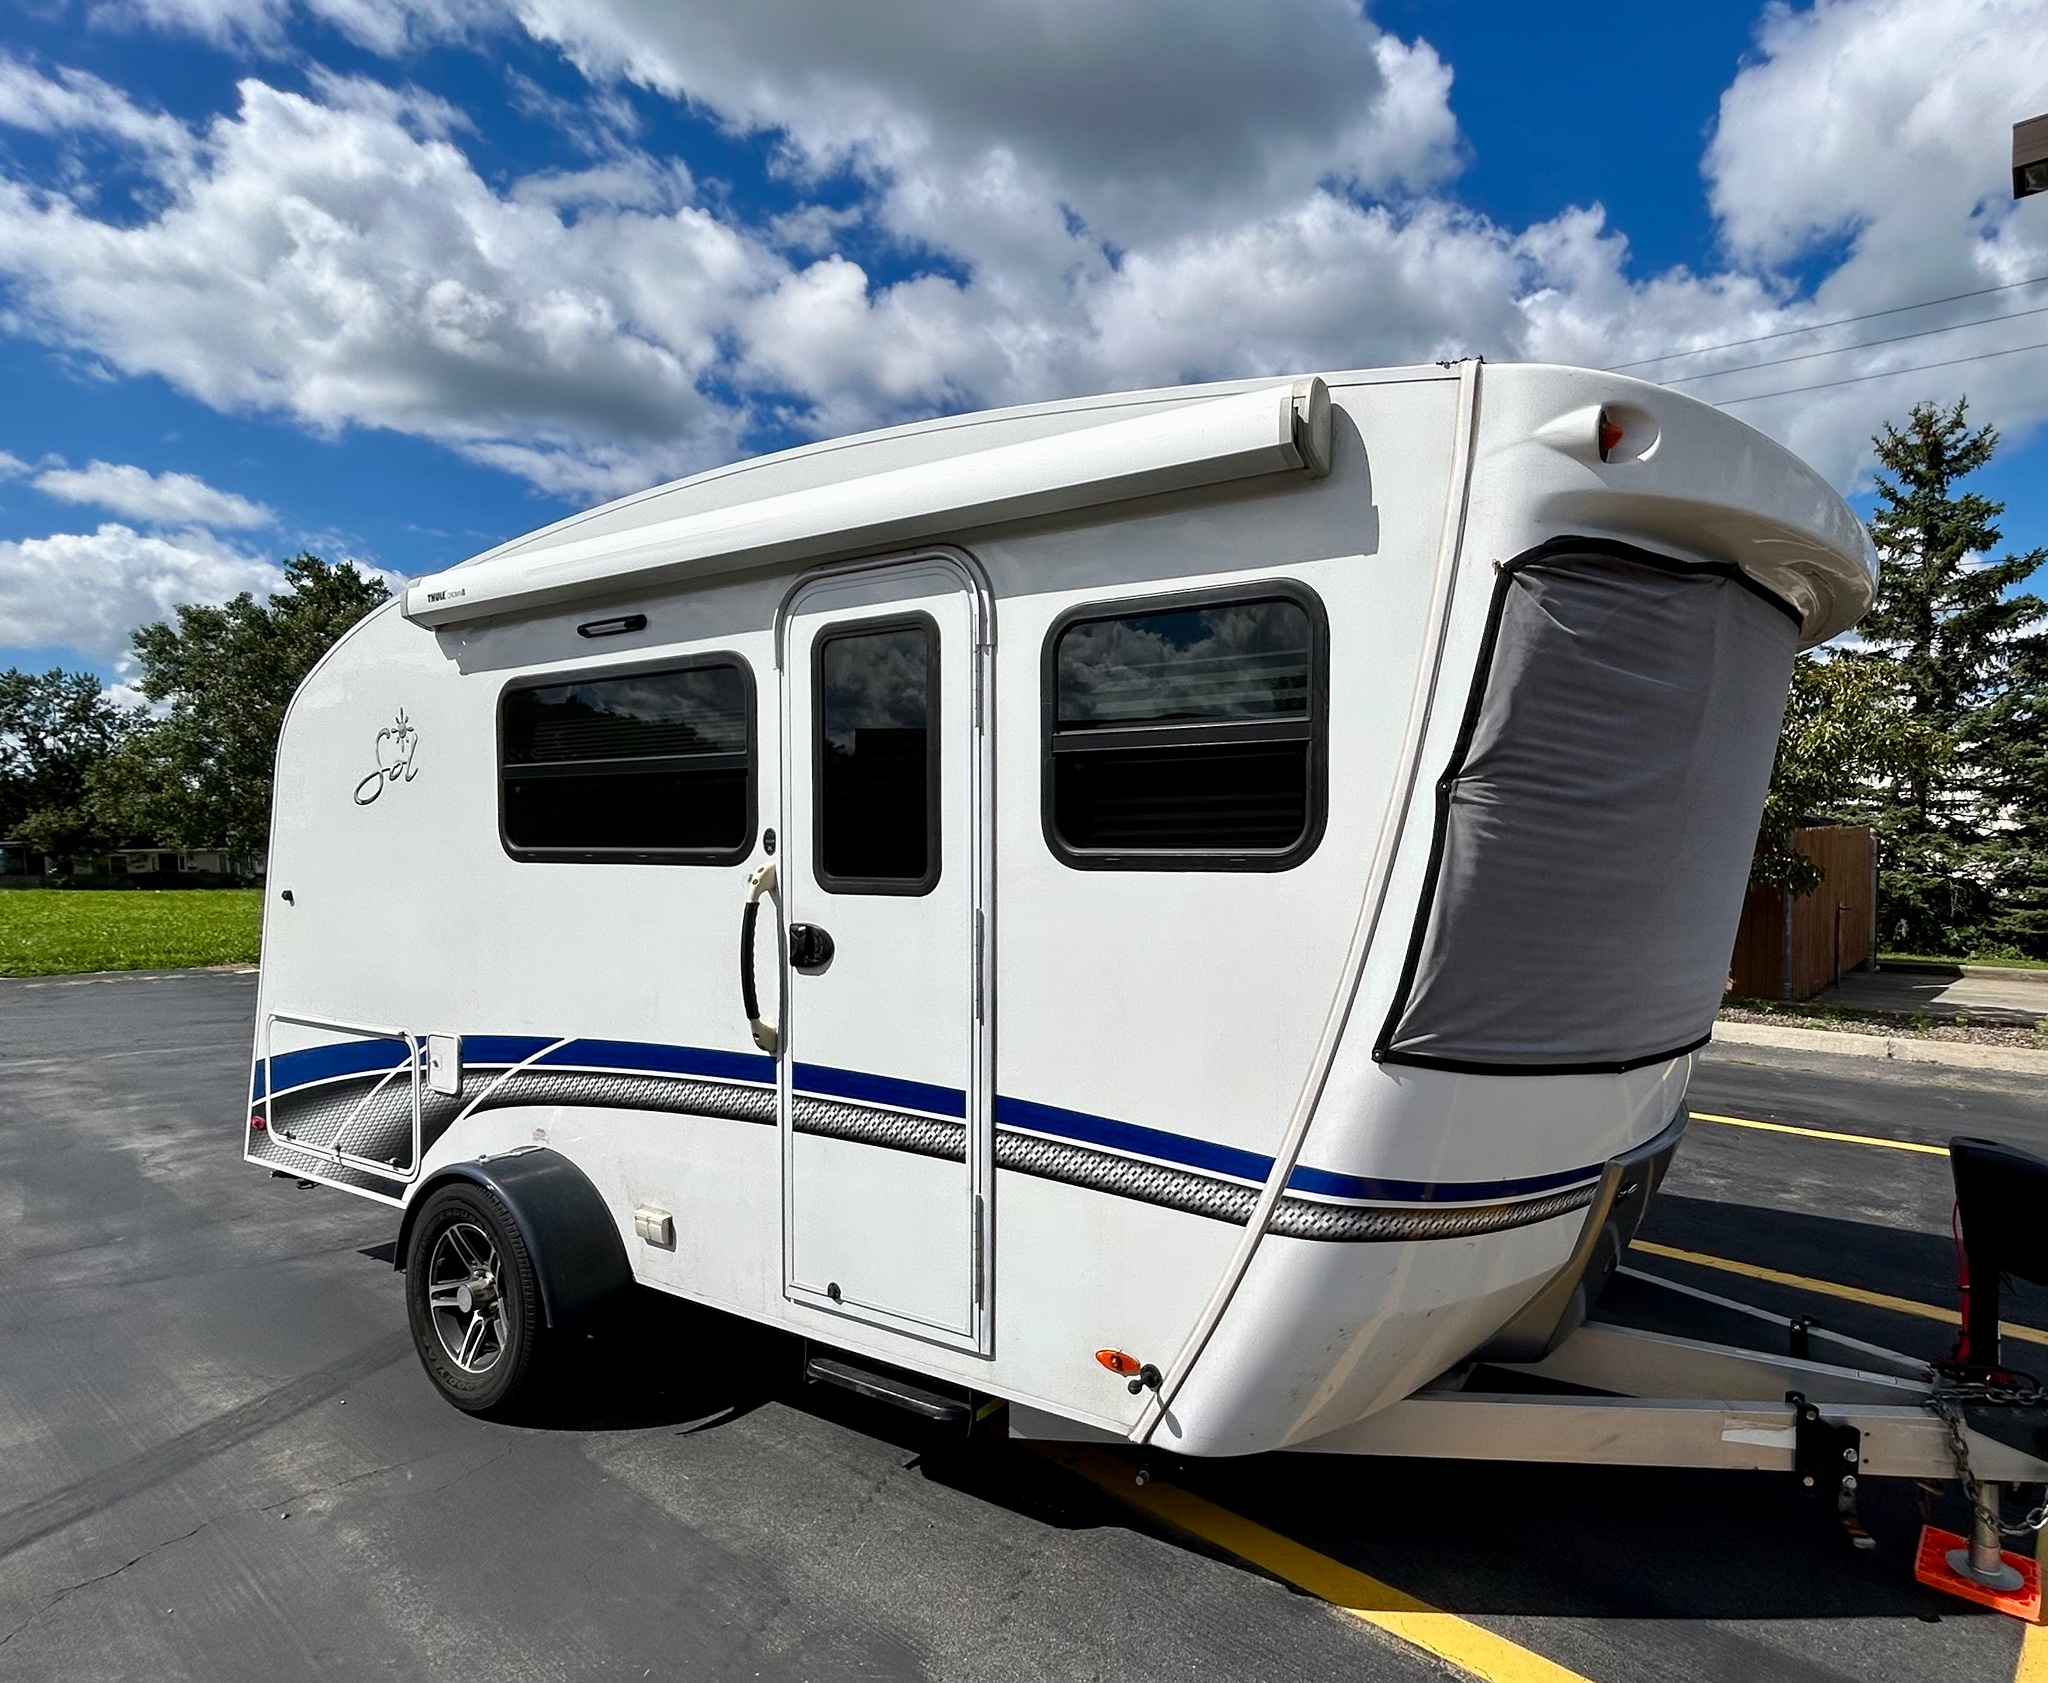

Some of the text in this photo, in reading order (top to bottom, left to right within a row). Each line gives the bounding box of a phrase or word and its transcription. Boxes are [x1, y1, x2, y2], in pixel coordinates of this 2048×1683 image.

[427, 590, 446, 603] THULE
[354, 727, 418, 805] Sol
[422, 1334, 484, 1391] GOODYEAR
